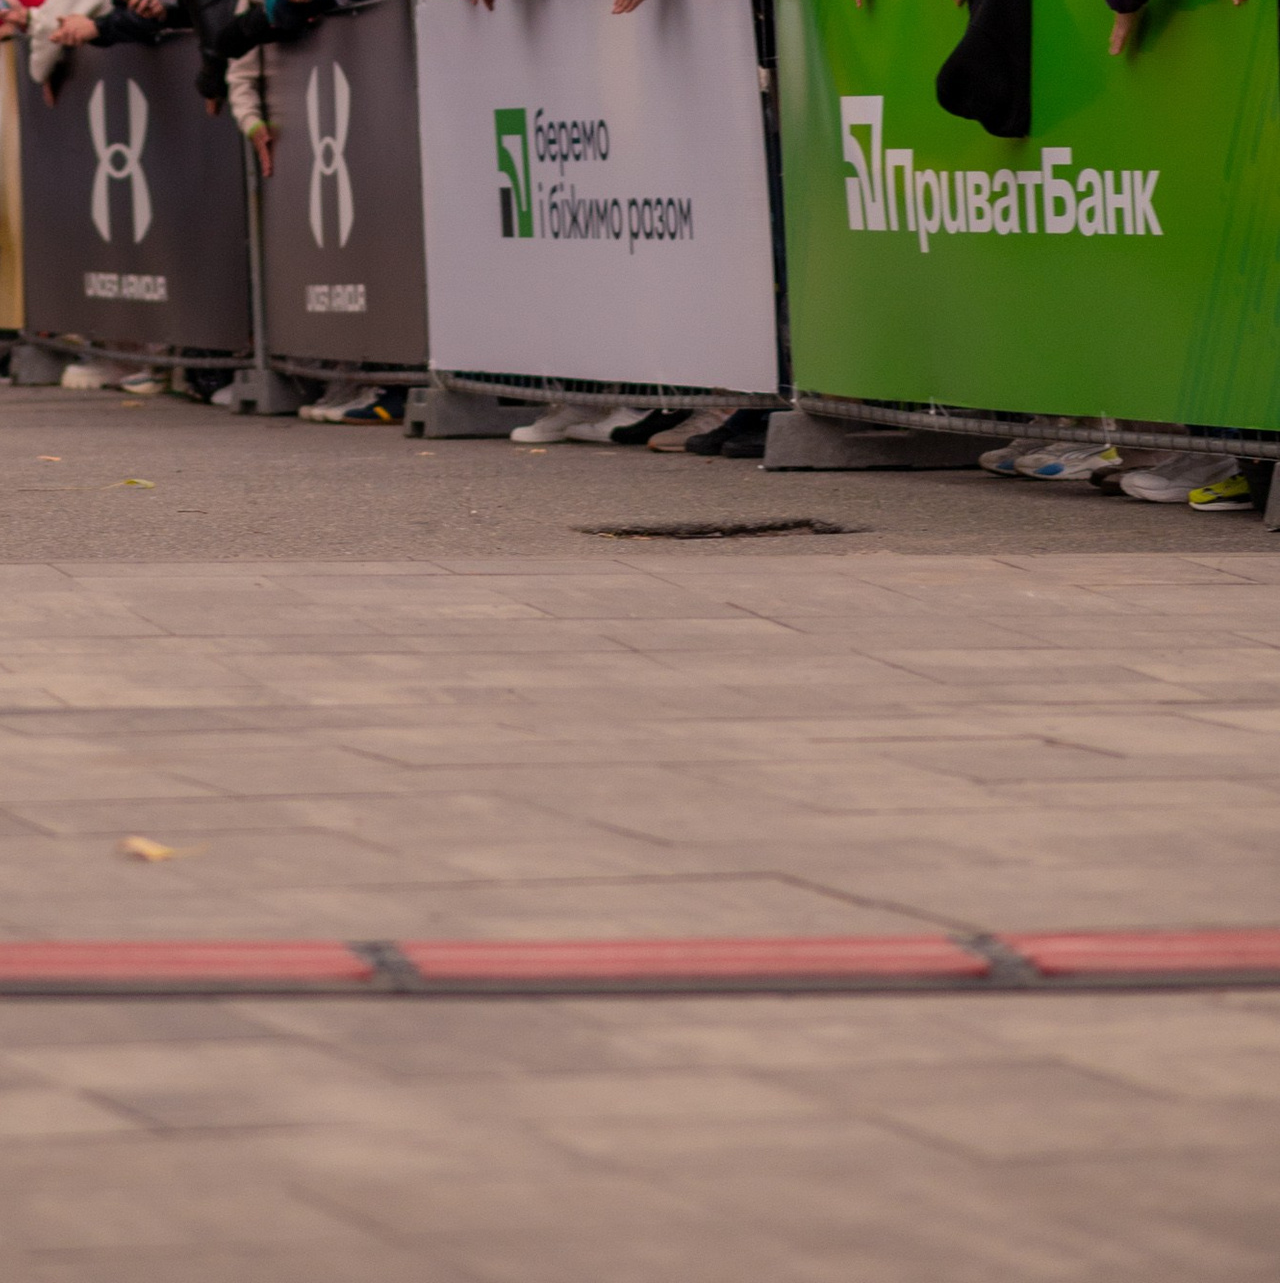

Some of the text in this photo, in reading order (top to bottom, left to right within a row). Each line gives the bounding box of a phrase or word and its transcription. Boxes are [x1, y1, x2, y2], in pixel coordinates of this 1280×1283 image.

[535, 108, 610, 177] беремо
[549, 182, 623, 240] біжимо
[628, 197, 694, 256] разом
[885, 147, 1163, 253] ПриватБанк
